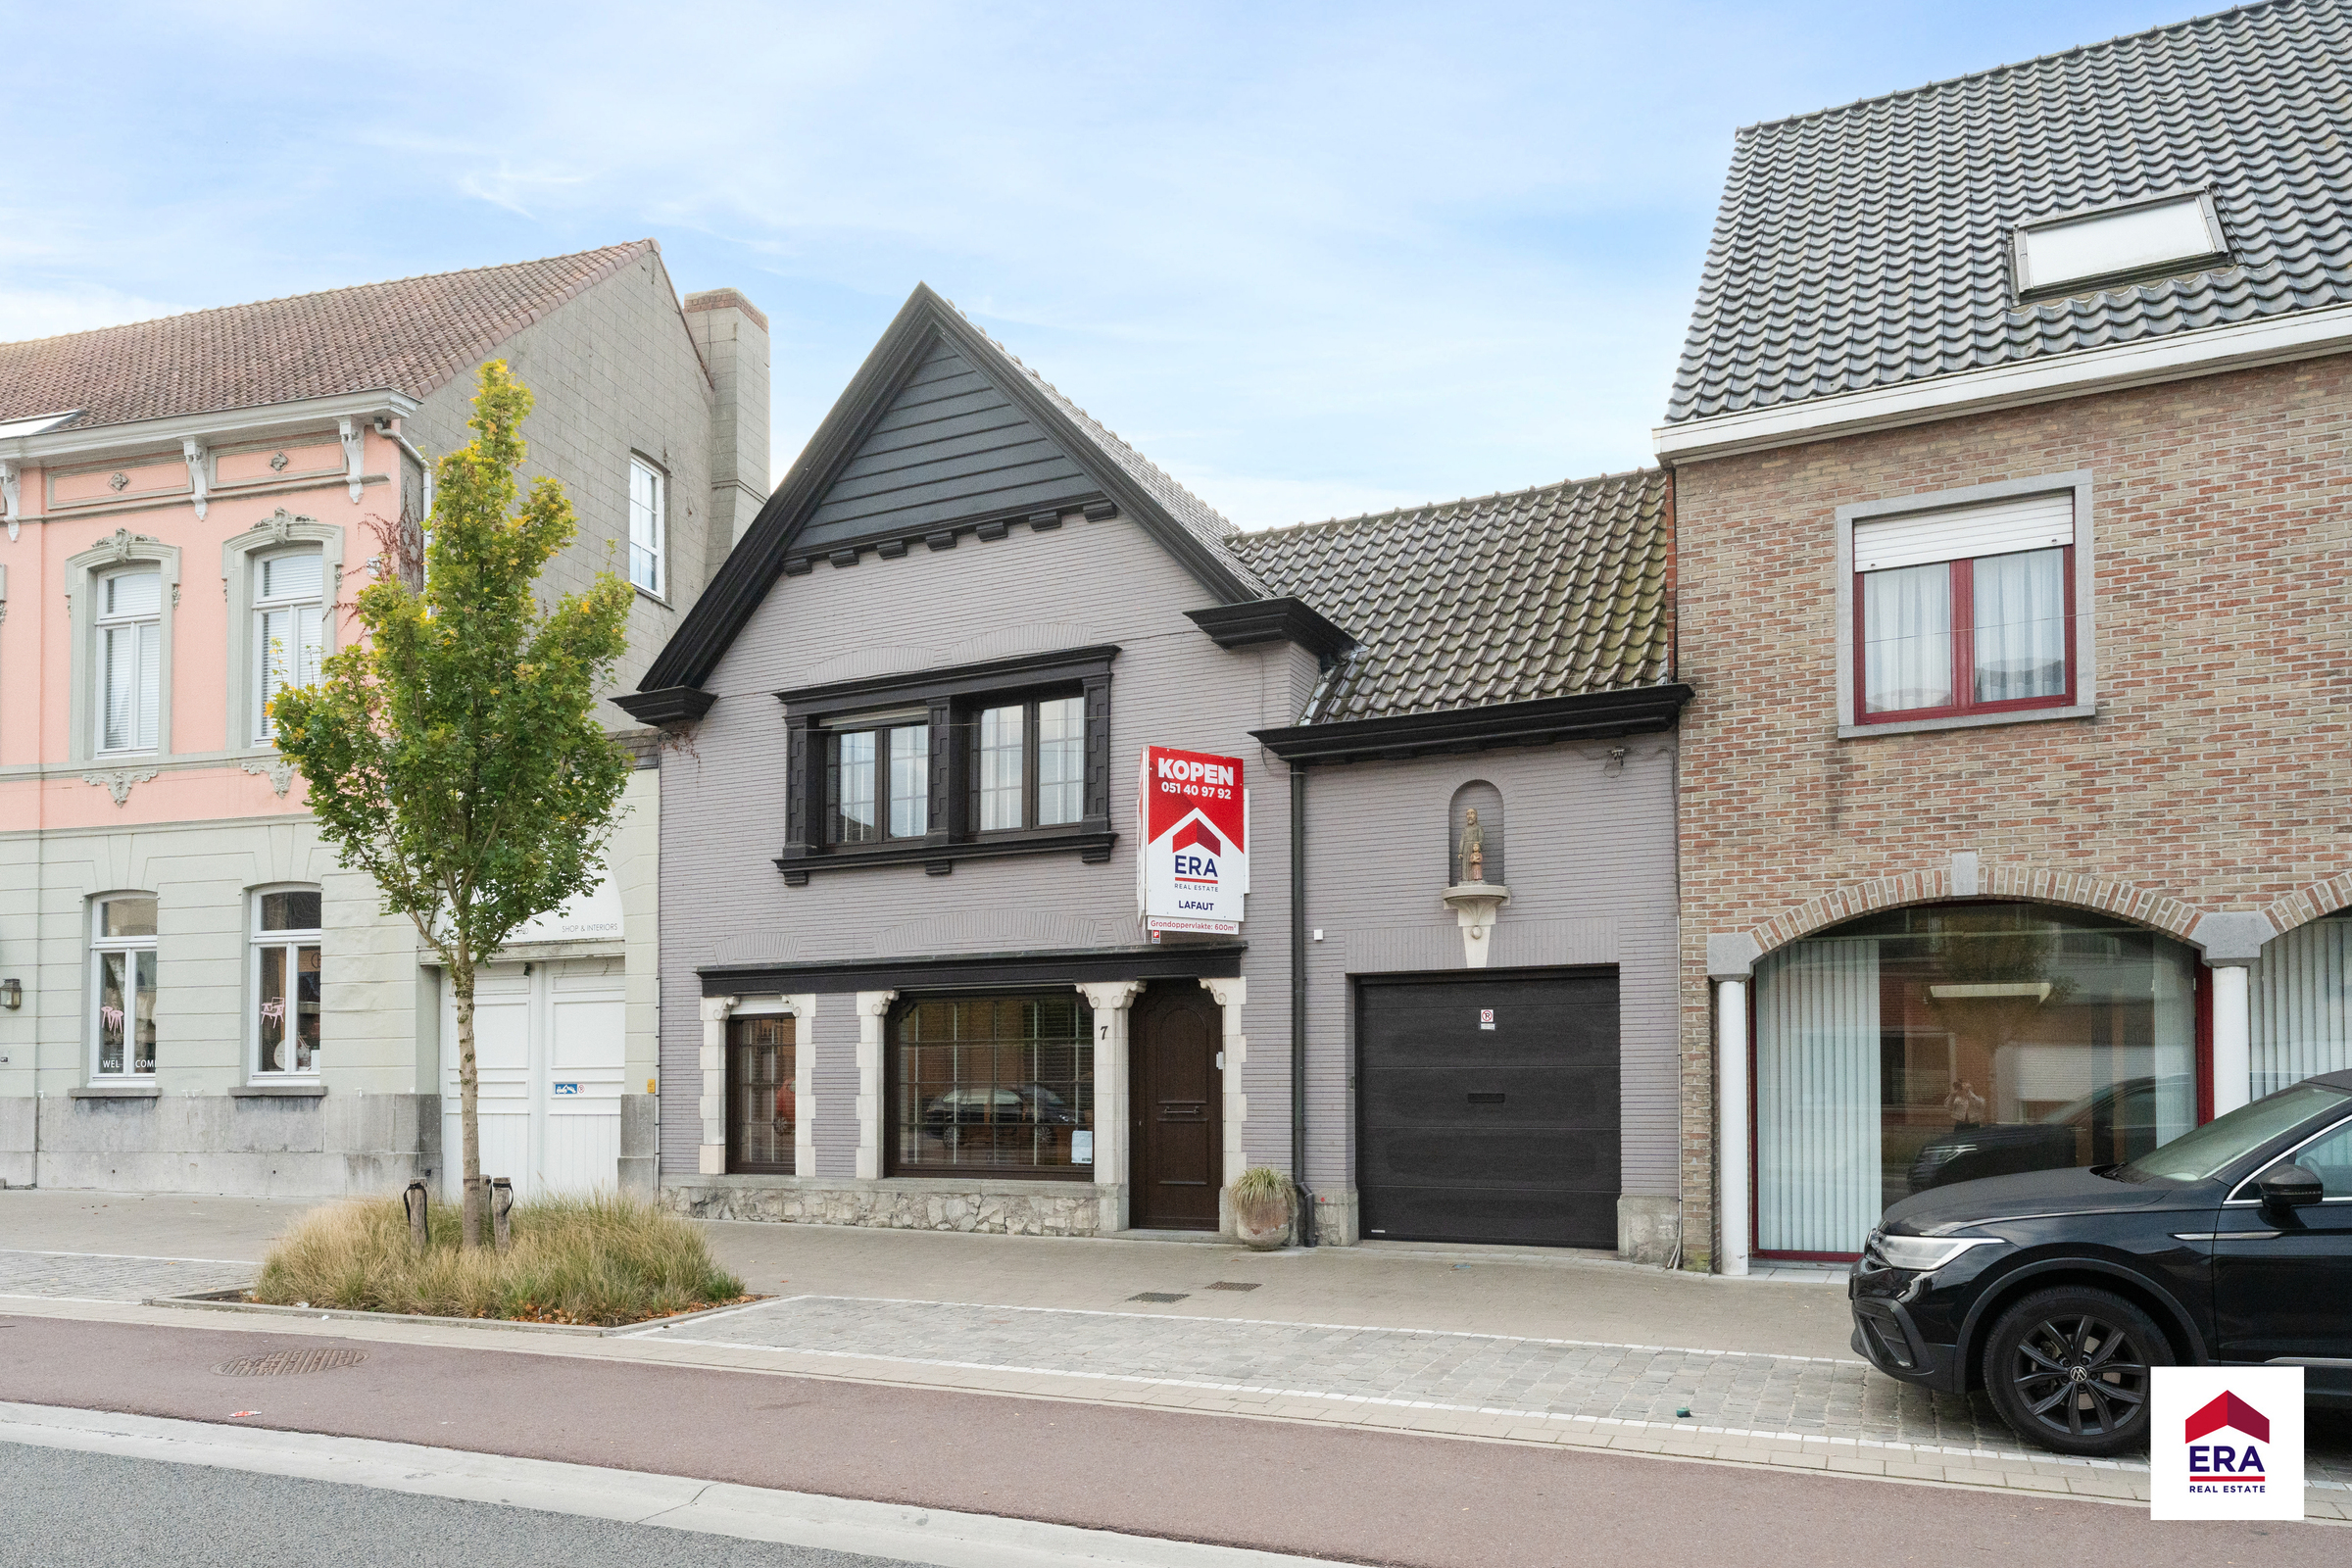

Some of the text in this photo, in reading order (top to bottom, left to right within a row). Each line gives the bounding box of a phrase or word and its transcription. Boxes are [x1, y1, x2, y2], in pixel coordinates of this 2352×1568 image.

[1157, 757, 1234, 787] KOPEN
[1160, 781, 1232, 800] 051 40 97 92
[1174, 855, 1218, 878] ERA
[1194, 884, 1219, 893] ESTATE
[1178, 900, 1214, 911] LAFAUT
[586, 923, 618, 932] INTERIORS
[1150, 919, 1213, 931] Grondoppervlakte:
[1100, 1025, 1108, 1041] 7
[102, 1059, 120, 1068] WEL
